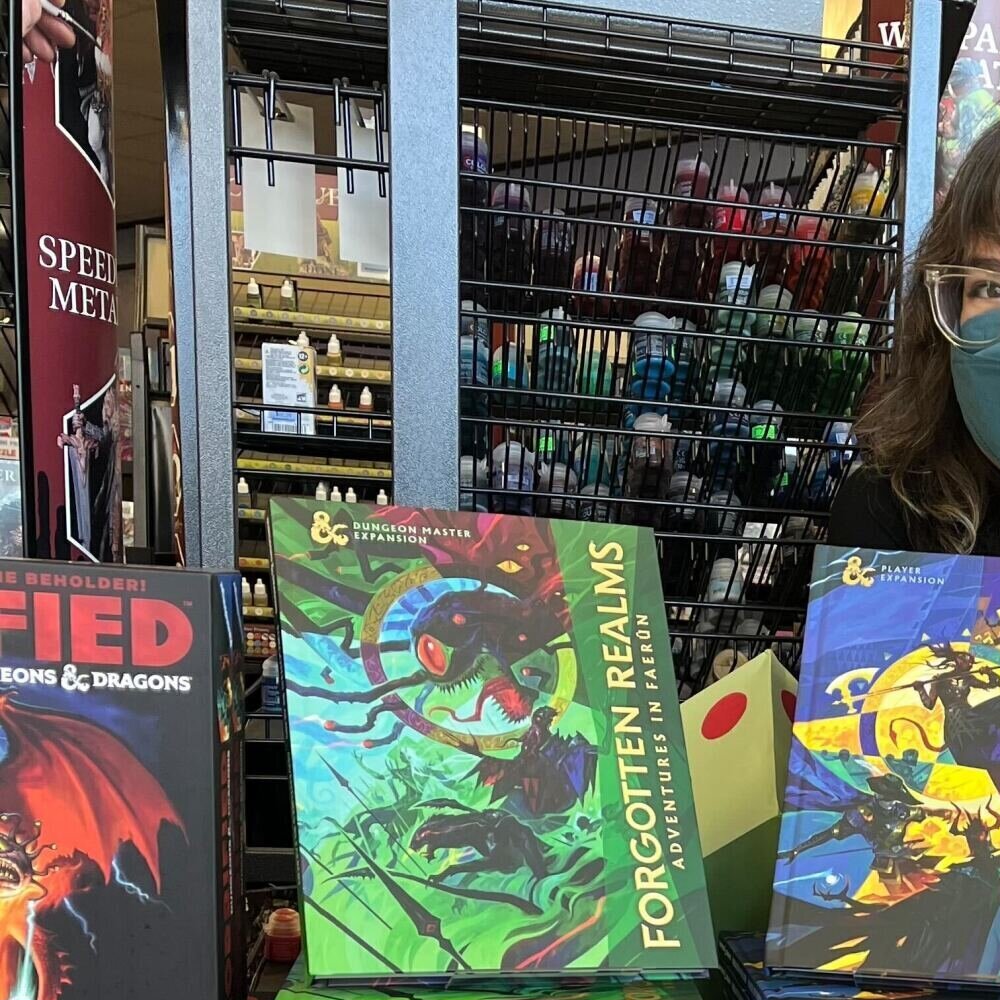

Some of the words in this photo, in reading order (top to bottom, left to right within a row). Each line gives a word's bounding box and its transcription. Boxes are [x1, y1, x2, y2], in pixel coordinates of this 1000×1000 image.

[353, 521, 418, 535] DUNGEON
[422, 527, 472, 539] MASTER
[354, 531, 427, 545] EXPANSION
[880, 574, 945, 585] EXPANSION
[881, 565, 921, 575] PLAYER
[25, 571, 147, 592] BEHOLDER!
[588, 541, 637, 690] REALMS
[0, 667, 58, 686] EONS
[91, 671, 193, 692] DRAGONS
[648, 700, 664, 723] IN
[655, 732, 686, 871] ADVENTURES
[611, 705, 681, 949] FORGOTTEN
